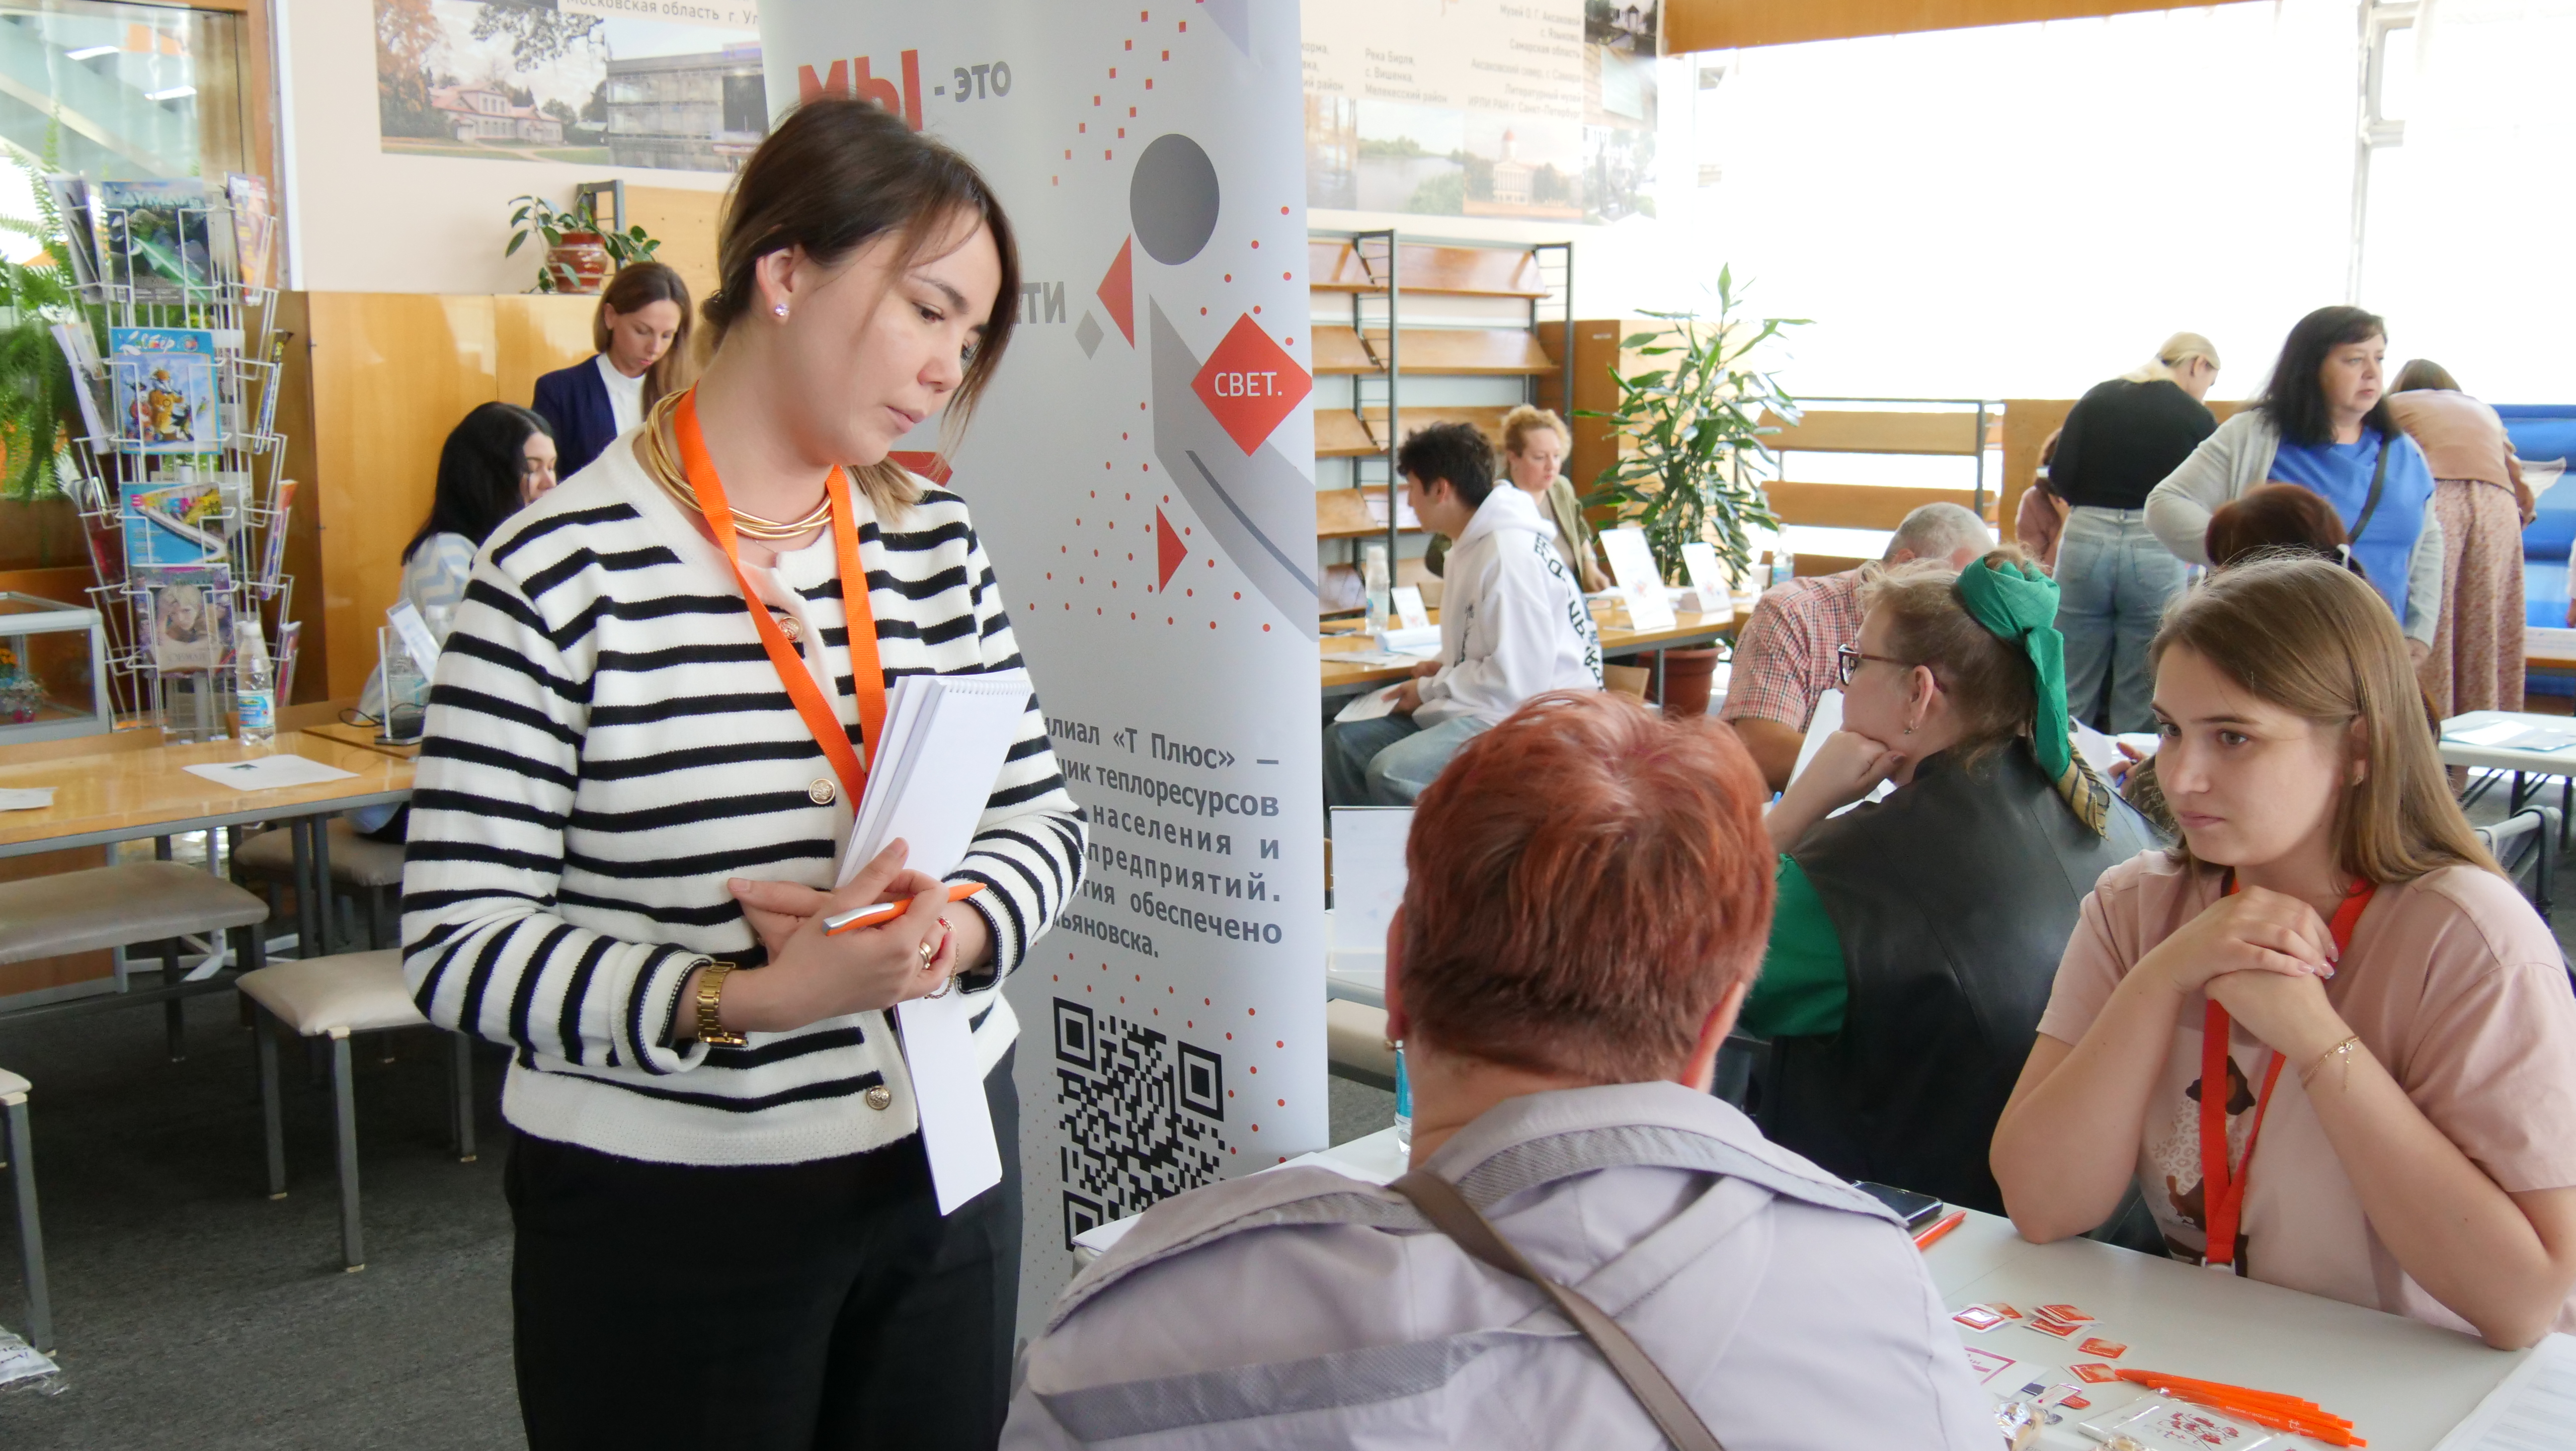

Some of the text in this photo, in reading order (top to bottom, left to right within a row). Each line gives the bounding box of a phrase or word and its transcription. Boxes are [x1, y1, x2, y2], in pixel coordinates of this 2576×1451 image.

[662, 3, 719, 20] область
[1500, 4, 1524, 18] Музей
[1365, 48, 1416, 67] Река Бирля,
[1510, 38, 1581, 59] Самарская область
[1317, 78, 1344, 91] район
[1374, 67, 1414, 83] Вишенка,
[1365, 83, 1447, 103] Мелекесский район
[1015, 281, 1066, 324] ТИ
[1214, 372, 1283, 397] СВЕТ.
[1113, 727, 1138, 754] «Т
[1151, 732, 1236, 770] Плюс»
[1096, 766, 1280, 817] теплоресурсов
[1093, 803, 1280, 860] населения и
[1088, 842, 1281, 902] предприятий.
[1129, 890, 1283, 945] обеспечено
[1055, 910, 1159, 958] ьяновска.
